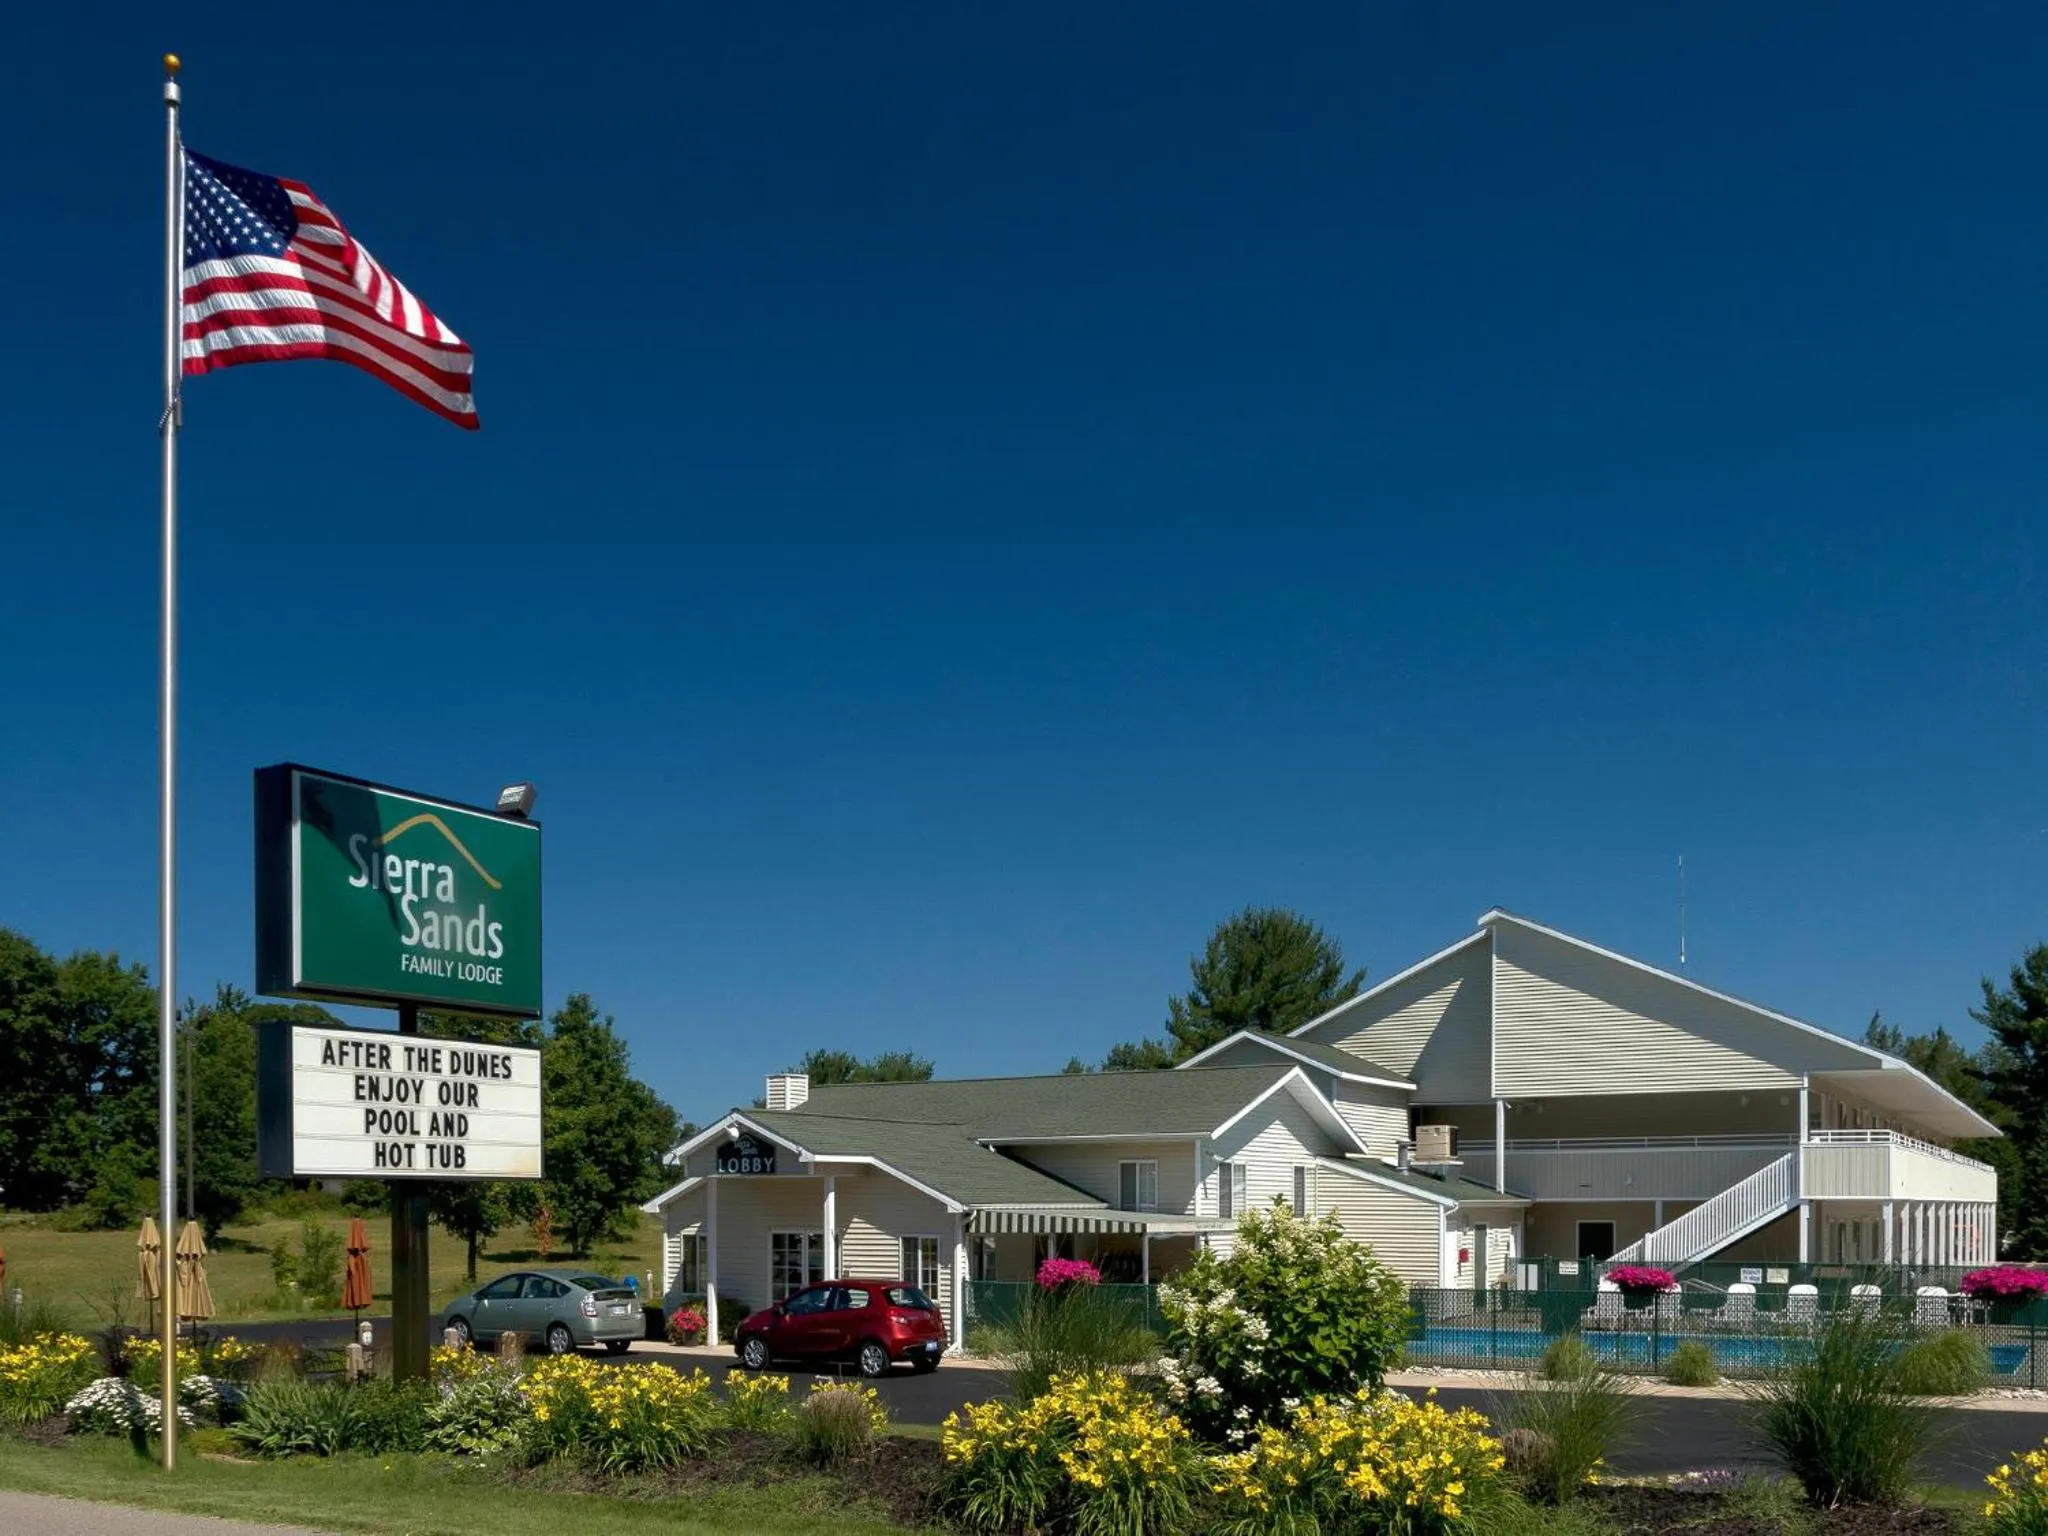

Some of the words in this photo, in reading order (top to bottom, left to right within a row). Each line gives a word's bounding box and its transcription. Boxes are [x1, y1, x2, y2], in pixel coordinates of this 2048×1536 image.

[348, 833, 455, 903] Sierra
[401, 893, 504, 959] Sands
[401, 953, 454, 978] FAMILY
[458, 962, 503, 985] LODGE
[322, 1039, 391, 1070] AFTER
[404, 1046, 442, 1073] THE
[450, 1050, 512, 1079] DUNES
[355, 1075, 424, 1104] ENJOY
[438, 1081, 479, 1107] OUR
[365, 1108, 420, 1136] POOL
[429, 1112, 468, 1137] AND
[375, 1142, 415, 1168] HOT
[426, 1143, 466, 1169] TUB
[718, 1157, 774, 1173] LOBBY
